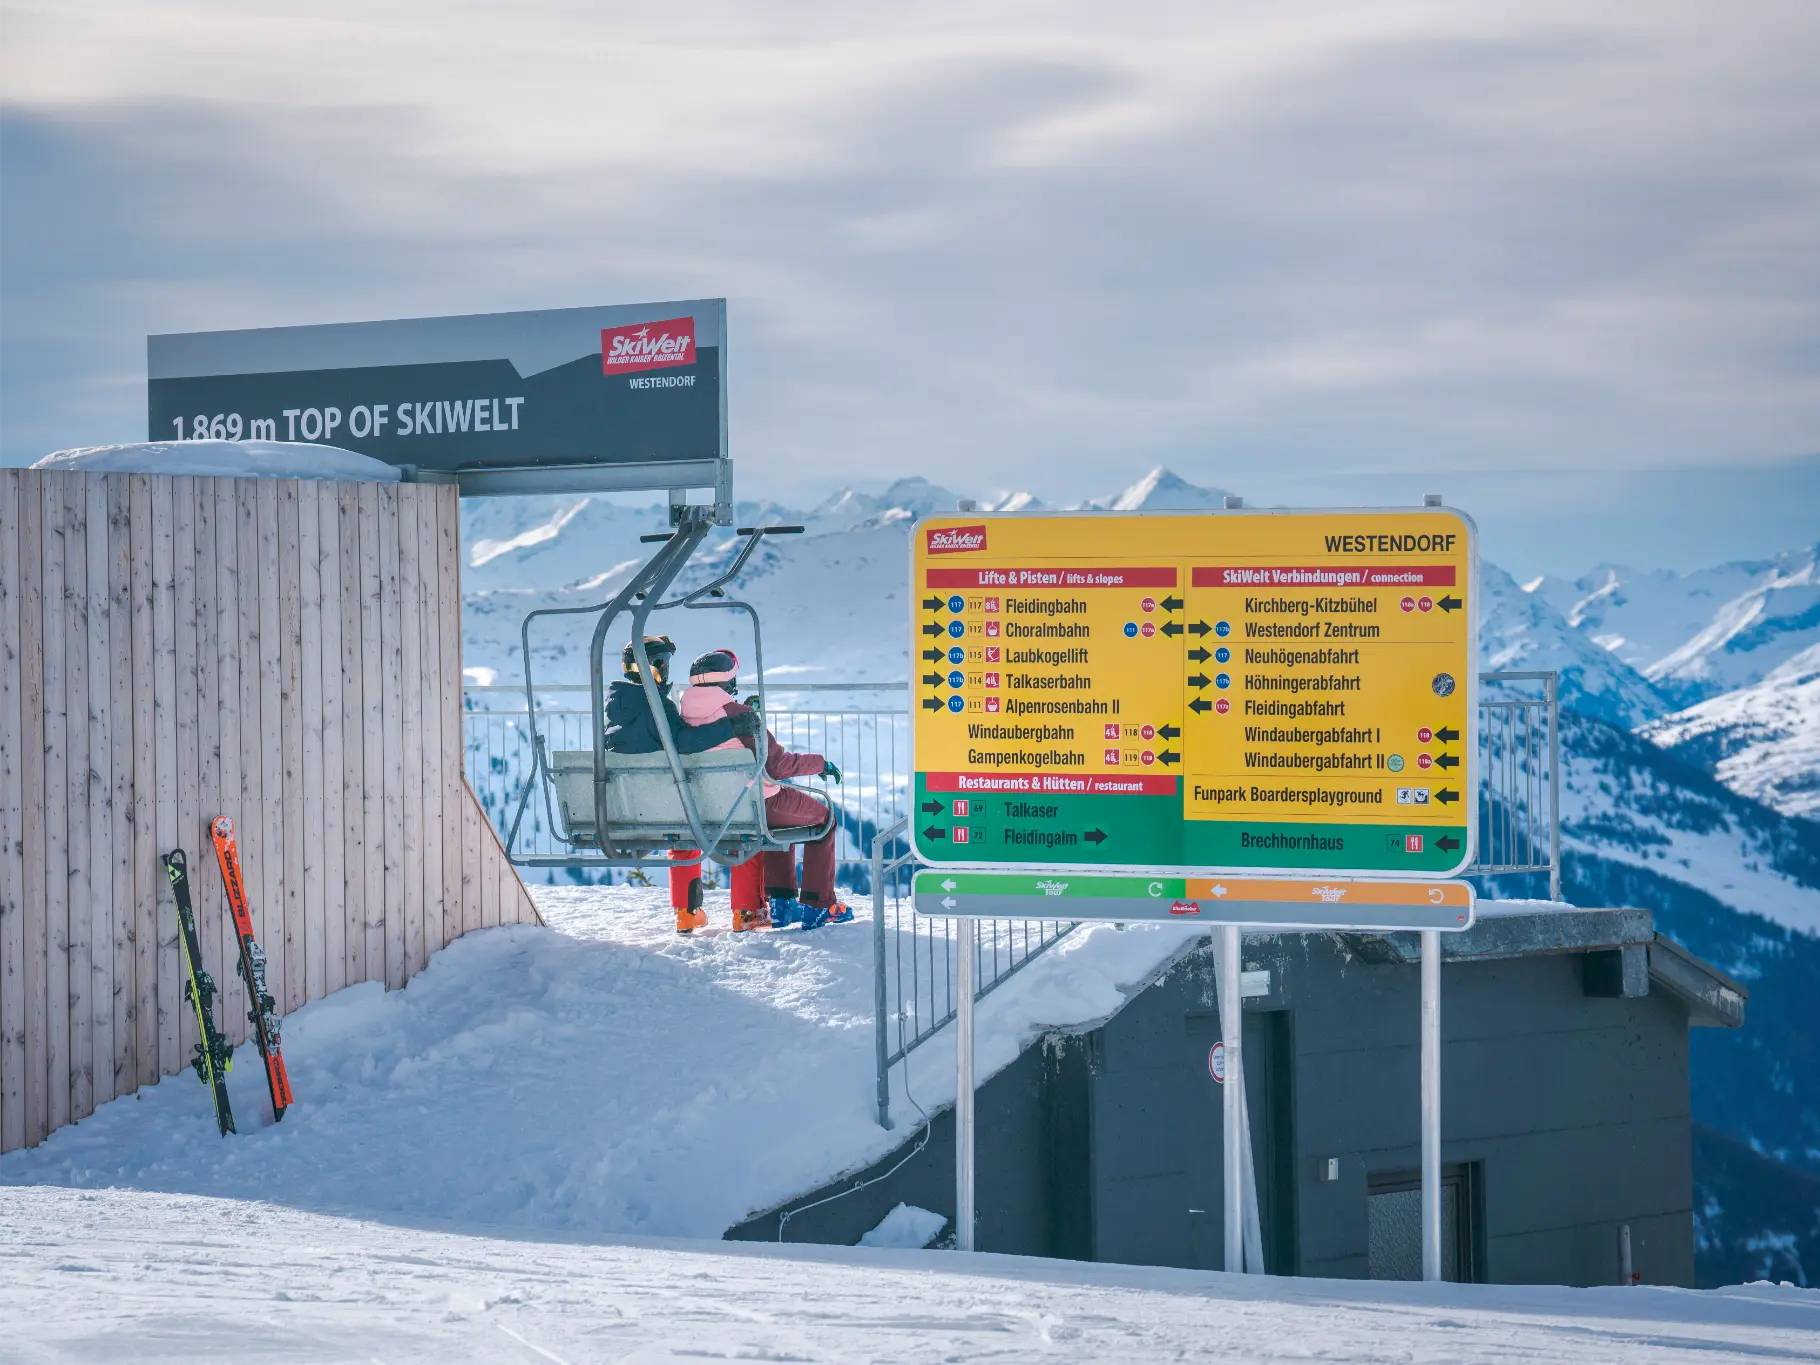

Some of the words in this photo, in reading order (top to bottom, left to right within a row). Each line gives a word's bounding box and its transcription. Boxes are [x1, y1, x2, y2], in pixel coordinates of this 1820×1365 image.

[609, 331, 691, 356] SkiWelt
[629, 375, 696, 389] WESTENDORF
[250, 417, 276, 441] m
[283, 407, 342, 440] TOP
[349, 404, 389, 438] OF
[397, 397, 525, 436] SKIWELT
[931, 532, 984, 545] SkiWelt
[1325, 535, 1456, 552] WESTENDORF
[978, 571, 1006, 584] Lifte
[1008, 571, 1017, 584] &
[1020, 571, 1056, 584] Pisten
[1059, 571, 1064, 584] /
[1067, 574, 1085, 584] lifts
[1086, 574, 1094, 584] &
[1095, 574, 1123, 585] slopes
[1223, 570, 1270, 584] SkiWelt
[1272, 570, 1360, 586] Verbindungen
[1362, 569, 1368, 584] /
[1371, 572, 1423, 583] connection
[969, 601, 982, 609] 117
[1006, 599, 1087, 616] Fleidingbahn
[1245, 597, 1377, 615] Kirchberg-Kitzbühel
[1006, 622, 1090, 638] Choralmbahn
[1245, 622, 1320, 638] Westendorf
[1324, 623, 1380, 637] Zentrum
[969, 651, 982, 659] 115
[1006, 648, 1088, 666] Laubkogellift
[1245, 649, 1359, 667] Neuhögenabfahrt
[969, 676, 982, 684] 114
[1006, 673, 1091, 689] Talkaserbahn
[1245, 674, 1360, 693] Höhningerabfahrt
[1006, 699, 1108, 716] Alpenrosenbahn
[1245, 700, 1345, 719] Fleidingabfahrt
[968, 723, 1074, 742] Windaubergbahn
[1125, 728, 1138, 736] 118
[1245, 726, 1372, 746] Windaubergabfahrt
[968, 748, 1085, 768] Gampenkogelbahn
[1125, 753, 1138, 762] 119
[1245, 752, 1372, 772] Windaubergabfahrt
[958, 776, 1029, 790] Restaurants
[1032, 777, 1041, 790] &
[1043, 776, 1085, 791] Hütten
[1087, 777, 1093, 791] /
[1094, 780, 1143, 792] restaurant
[1194, 786, 1246, 803] Funpark
[1251, 787, 1382, 806] Boardersplayground
[1004, 802, 1058, 818] Talkaser
[1004, 829, 1078, 848] Fleidingalm
[1241, 832, 1344, 850] Brechhornhaus
[224, 851, 246, 918] BLIZZARD
